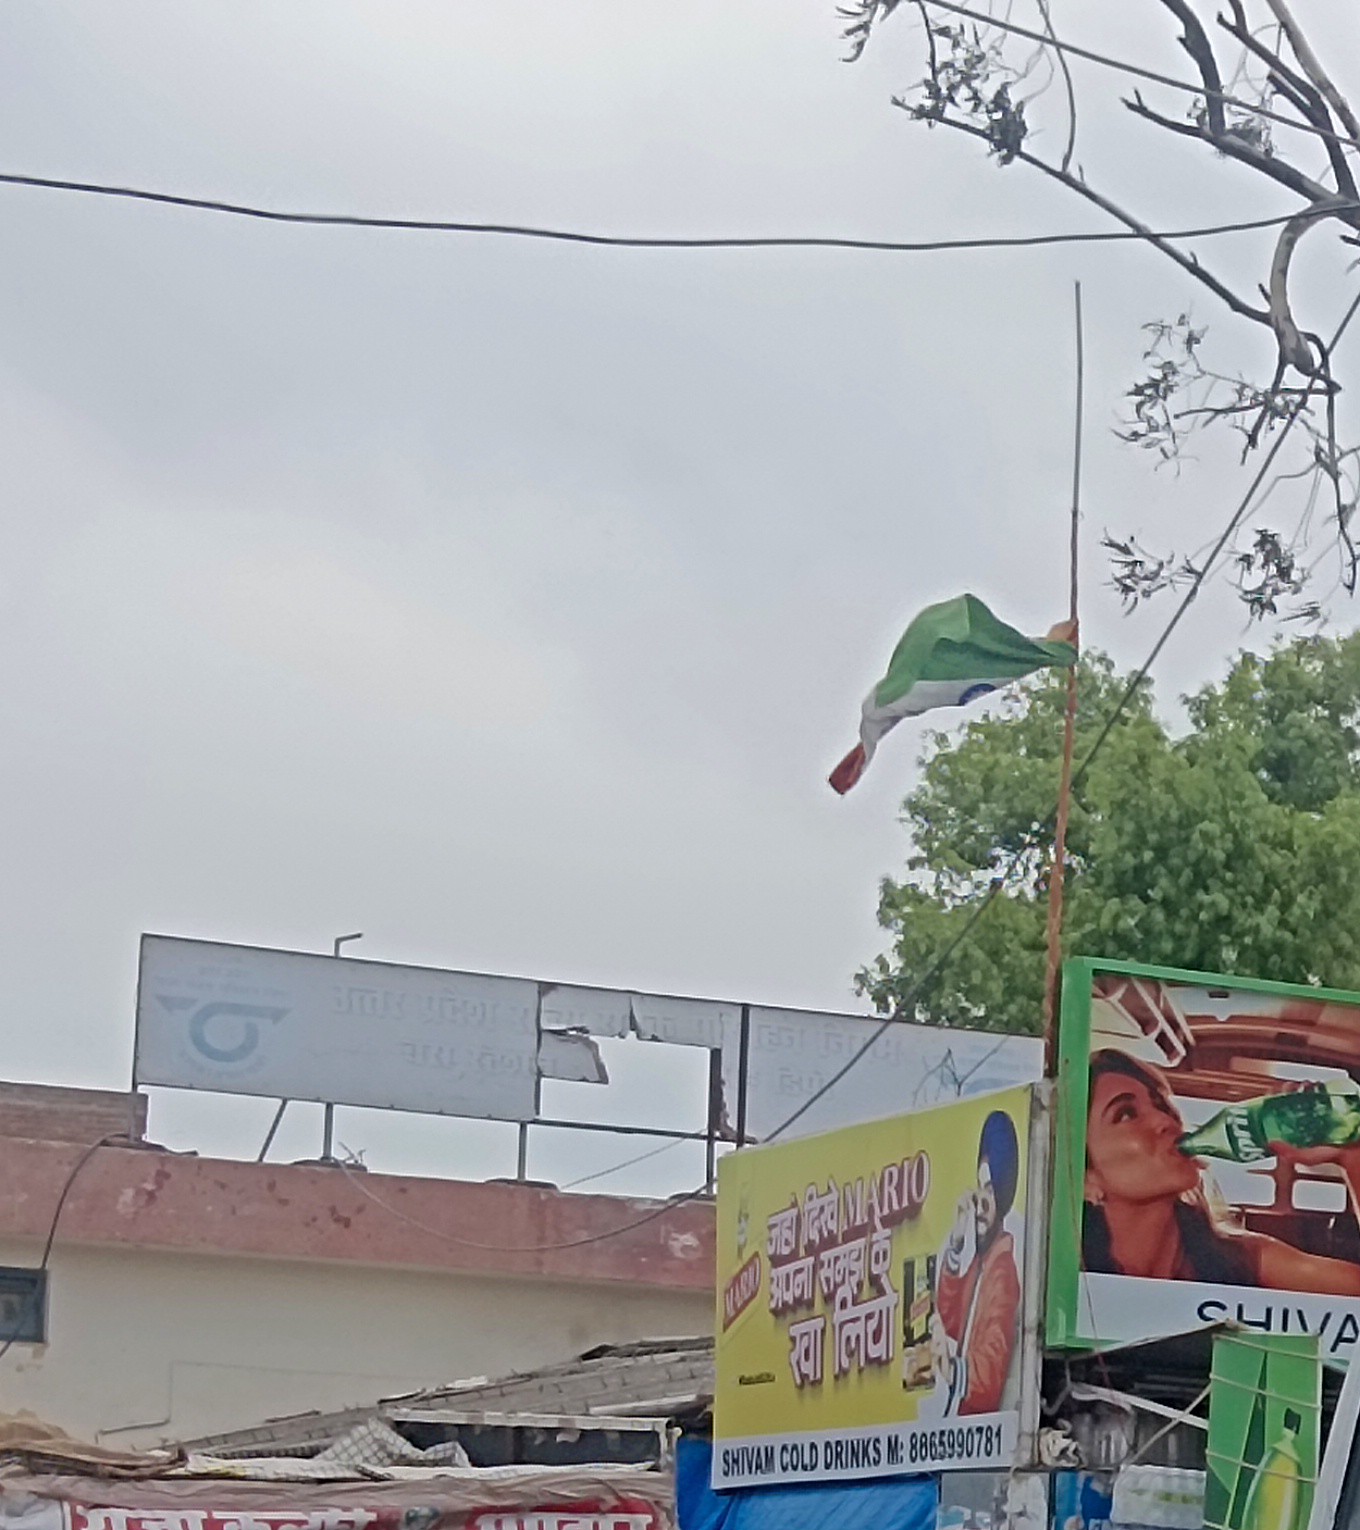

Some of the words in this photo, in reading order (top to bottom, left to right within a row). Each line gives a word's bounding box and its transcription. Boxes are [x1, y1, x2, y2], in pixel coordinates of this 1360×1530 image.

[842, 1151, 930, 1232] MARIO
[770, 1257, 816, 1310] अपना
[789, 1317, 825, 1386] खा
[722, 1445, 775, 1478] SHIVAM
[780, 1441, 819, 1472] COLD
[824, 1436, 881, 1470] DRINKS
[909, 1424, 1002, 1464] 8865990781
